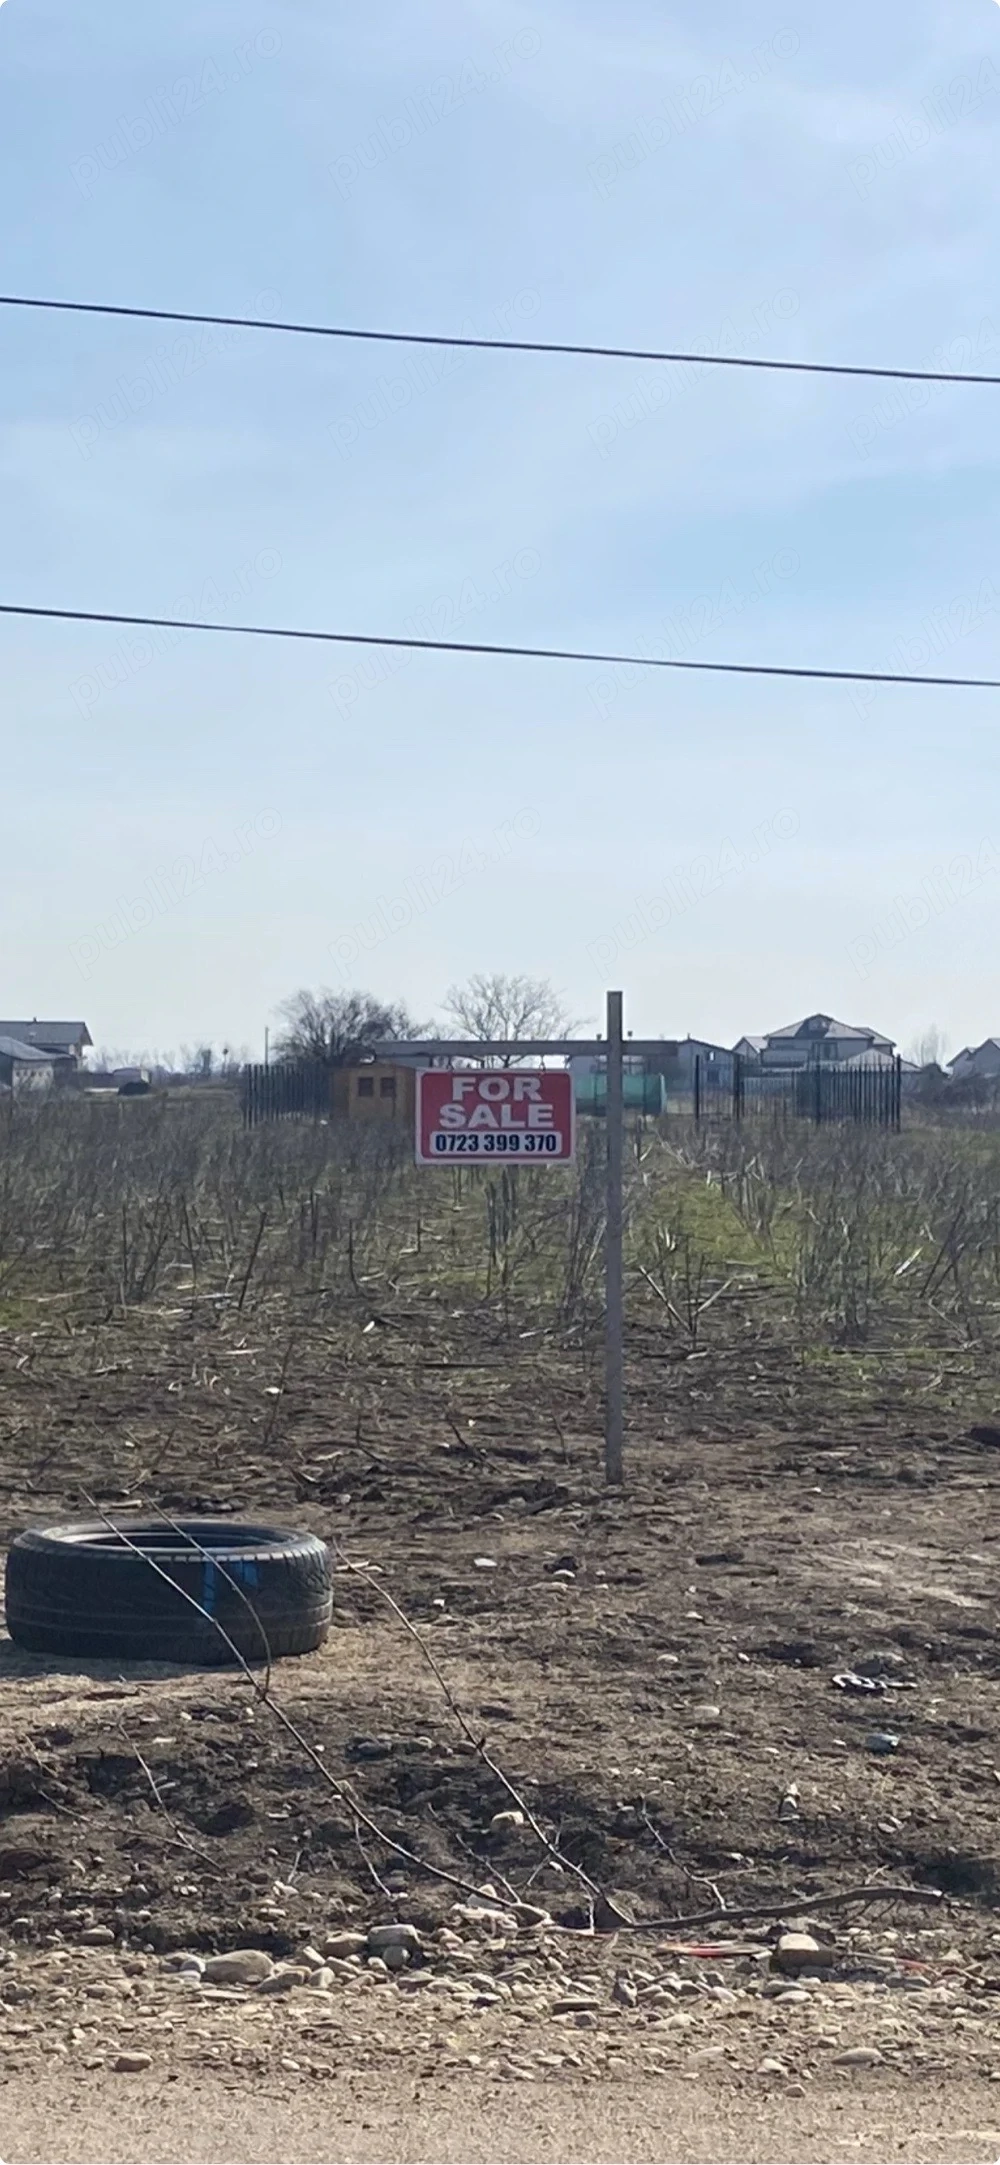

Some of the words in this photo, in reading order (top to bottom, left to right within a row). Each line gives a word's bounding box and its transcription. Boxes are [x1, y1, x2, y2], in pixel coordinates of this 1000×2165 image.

[452, 1077, 543, 1102] FOR
[439, 1103, 554, 1128] SALE
[435, 1134, 479, 1152] 0723
[483, 1134, 520, 1152] 399
[524, 1134, 557, 1152] 370
